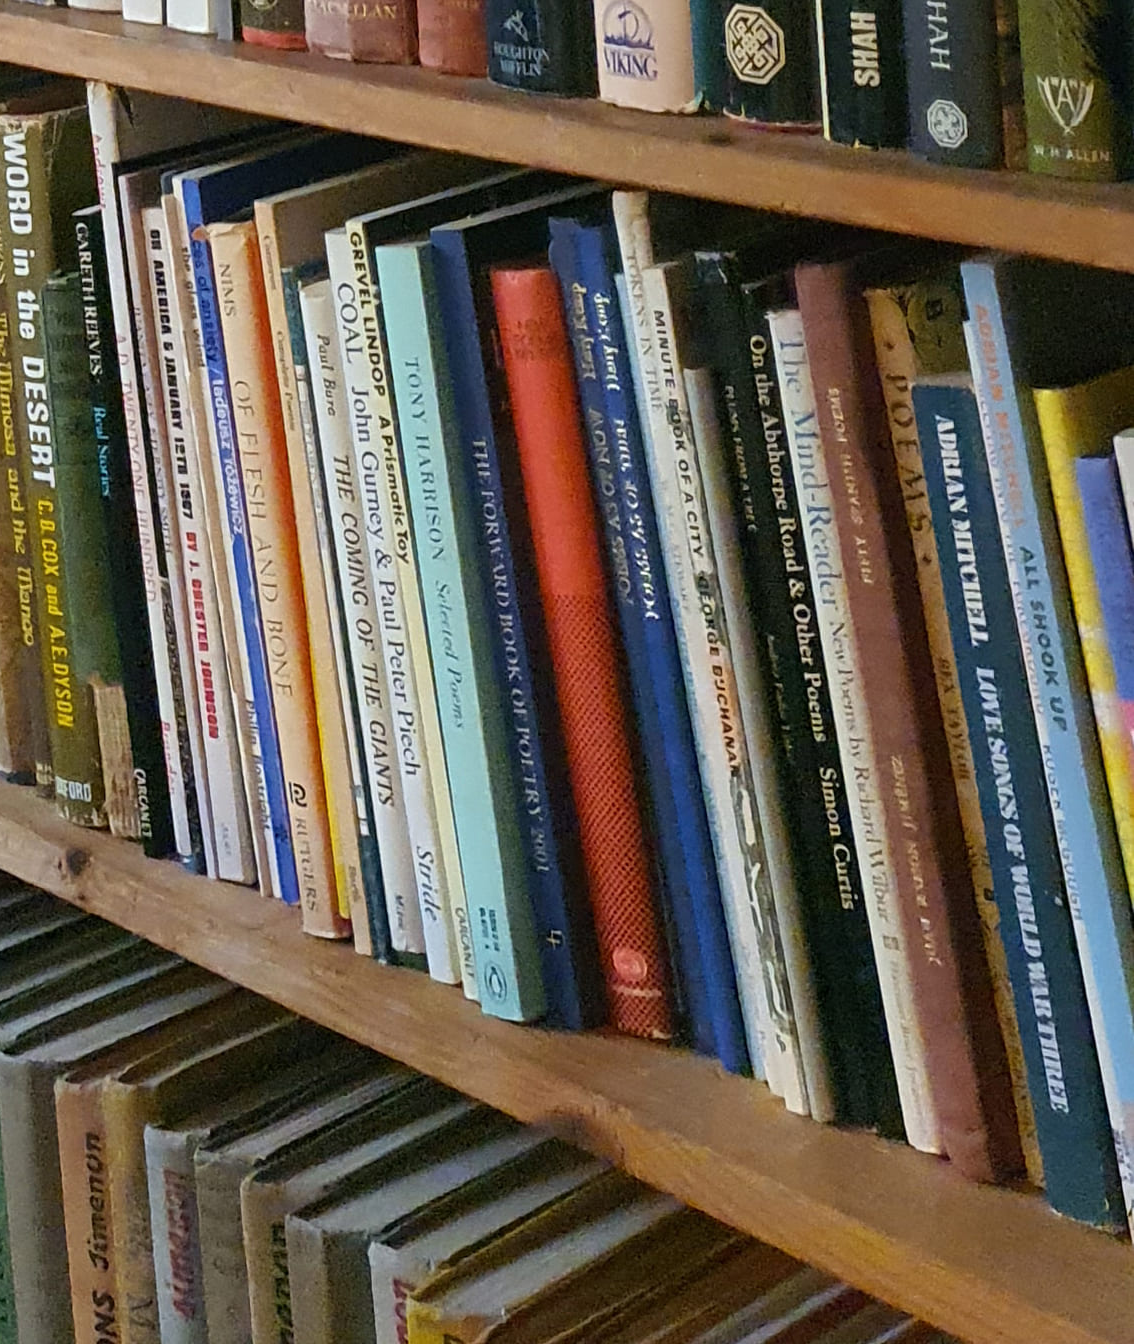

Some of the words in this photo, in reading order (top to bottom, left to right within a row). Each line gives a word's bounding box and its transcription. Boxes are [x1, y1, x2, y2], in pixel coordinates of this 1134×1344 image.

[603, 49, 658, 82] VIKING
[849, 10, 881, 89] SHAH
[0, 132, 35, 236] WORD
[12, 244, 35, 278] in
[218, 262, 236, 318] NIMS
[16, 287, 40, 341] the
[336, 281, 365, 365] COAL
[749, 334, 767, 366] On
[21, 356, 56, 489] DESERT
[233, 379, 253, 416] OF
[350, 384, 372, 444] John
[757, 371, 772, 404] the
[240, 428, 267, 523] FLESH
[332, 453, 355, 502] THE
[760, 409, 789, 513] Abthorpe
[934, 413, 969, 513] ADRIAN
[360, 450, 385, 549] Gurney
[253, 534, 279, 605] AND
[339, 510, 370, 606] COMING
[777, 516, 800, 574] Road
[378, 579, 402, 631] Paul
[951, 514, 990, 650] MITCHELL
[266, 615, 294, 698] BONE
[355, 617, 375, 656] OF
[386, 637, 409, 702] Peter
[793, 603, 819, 667] Other
[360, 661, 384, 709] THE
[802, 671, 828, 743] Poems
[972, 665, 1003, 732] LOVE
[369, 718, 395, 808] GIANTS
[396, 709, 417, 777] Piech
[984, 735, 1016, 820] SONGS
[132, 765, 153, 840] CARCANET
[819, 765, 843, 839] Simon
[1002, 820, 1023, 856] OF
[415, 843, 440, 923] Stride
[833, 842, 856, 913] Curtis
[1010, 861, 1044, 957] WORLD
[1025, 958, 1052, 1022] WAR
[1035, 1022, 1070, 1115] THREE
